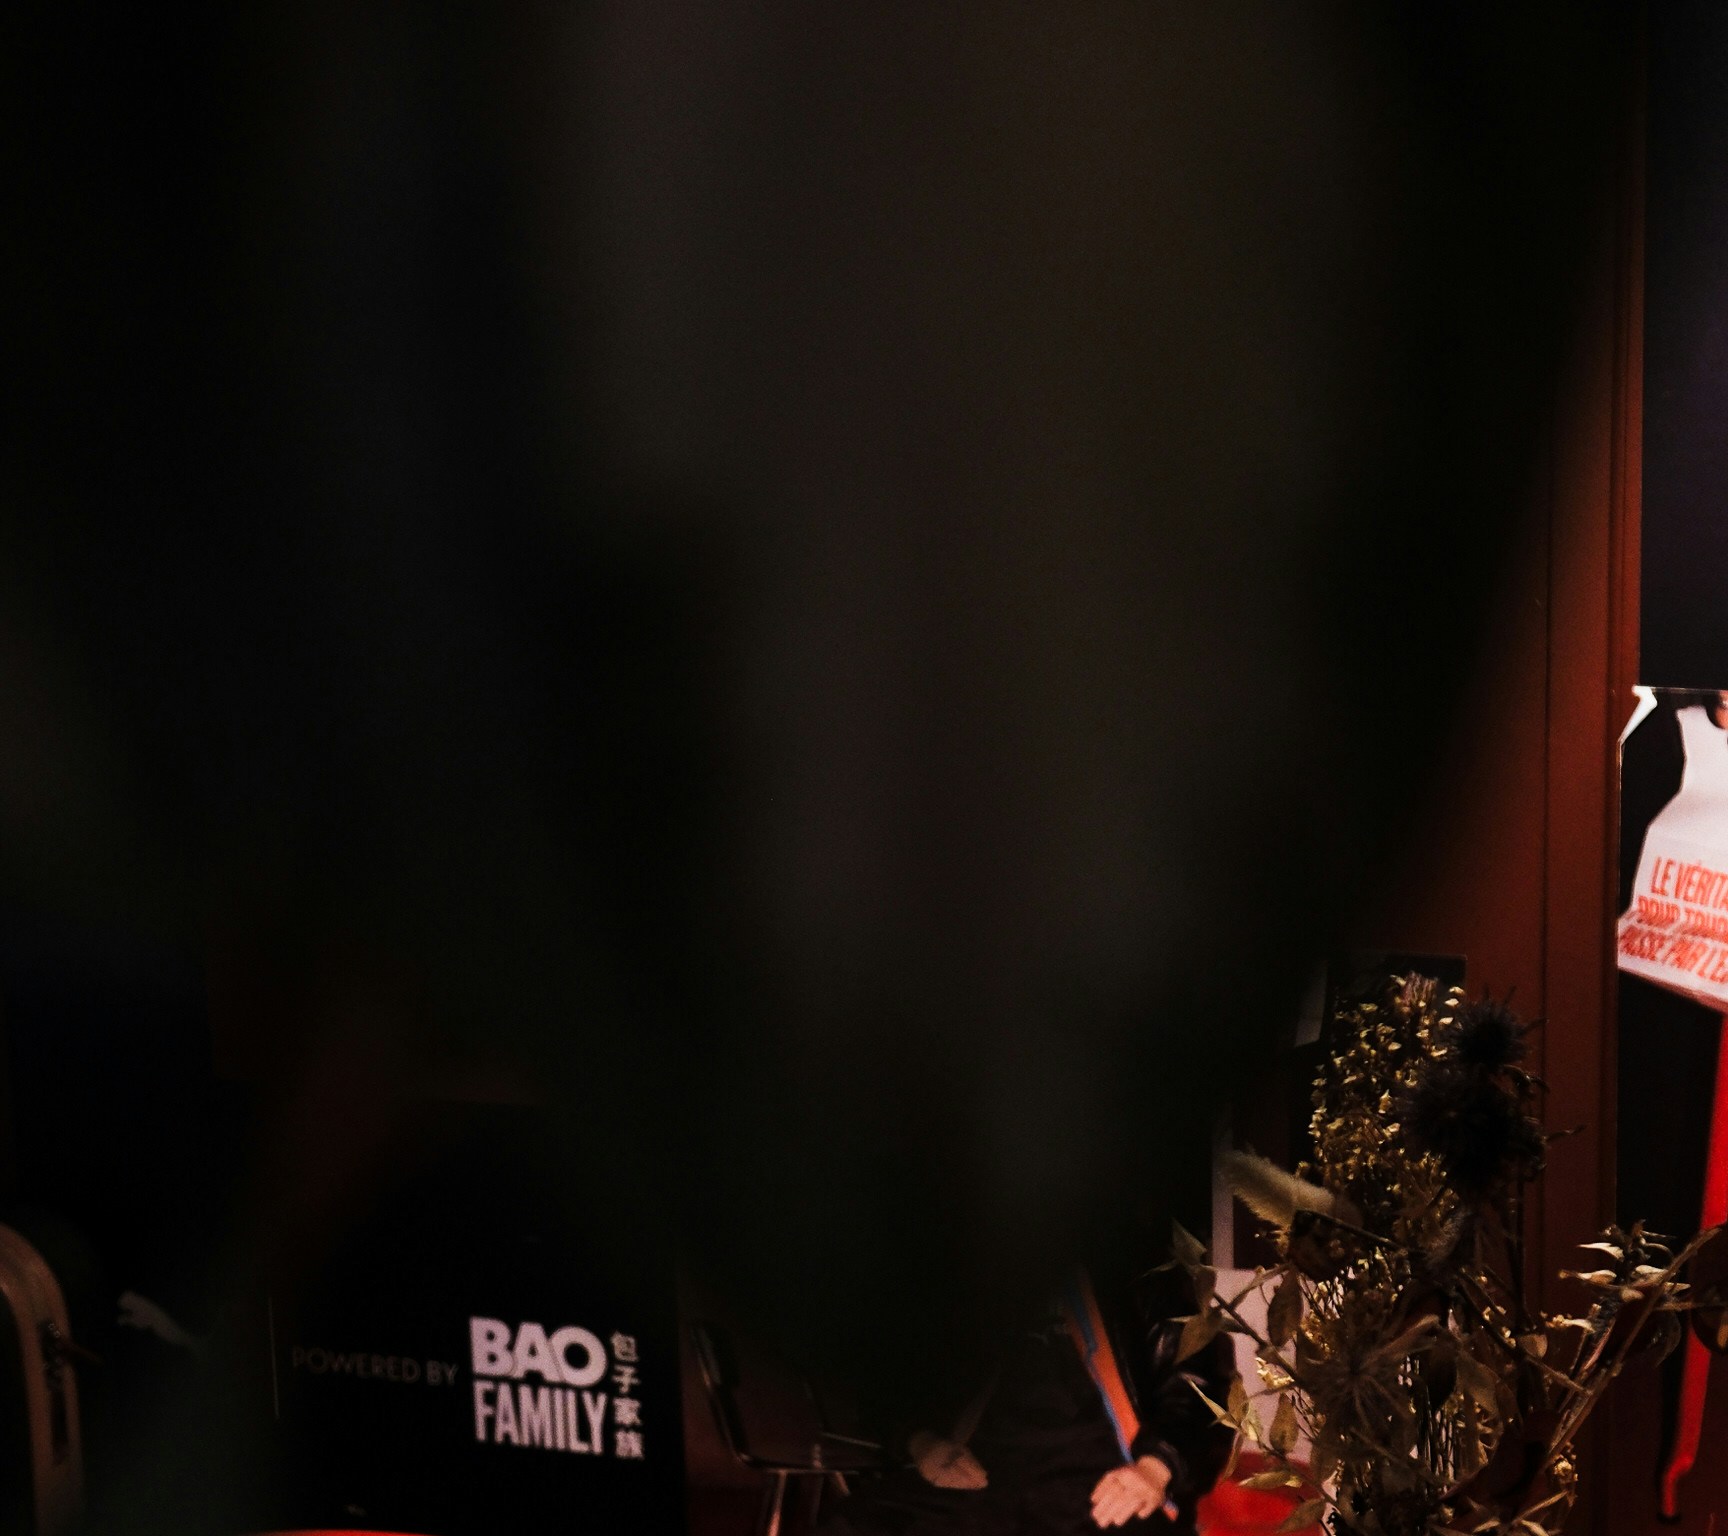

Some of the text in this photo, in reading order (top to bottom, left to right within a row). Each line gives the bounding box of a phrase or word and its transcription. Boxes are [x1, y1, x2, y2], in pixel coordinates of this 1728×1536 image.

[1651, 857, 1674, 897] LE
[292, 1345, 460, 1388] POWERED BY
[469, 1315, 608, 1390] BAO
[472, 1379, 609, 1457] FAMILY
